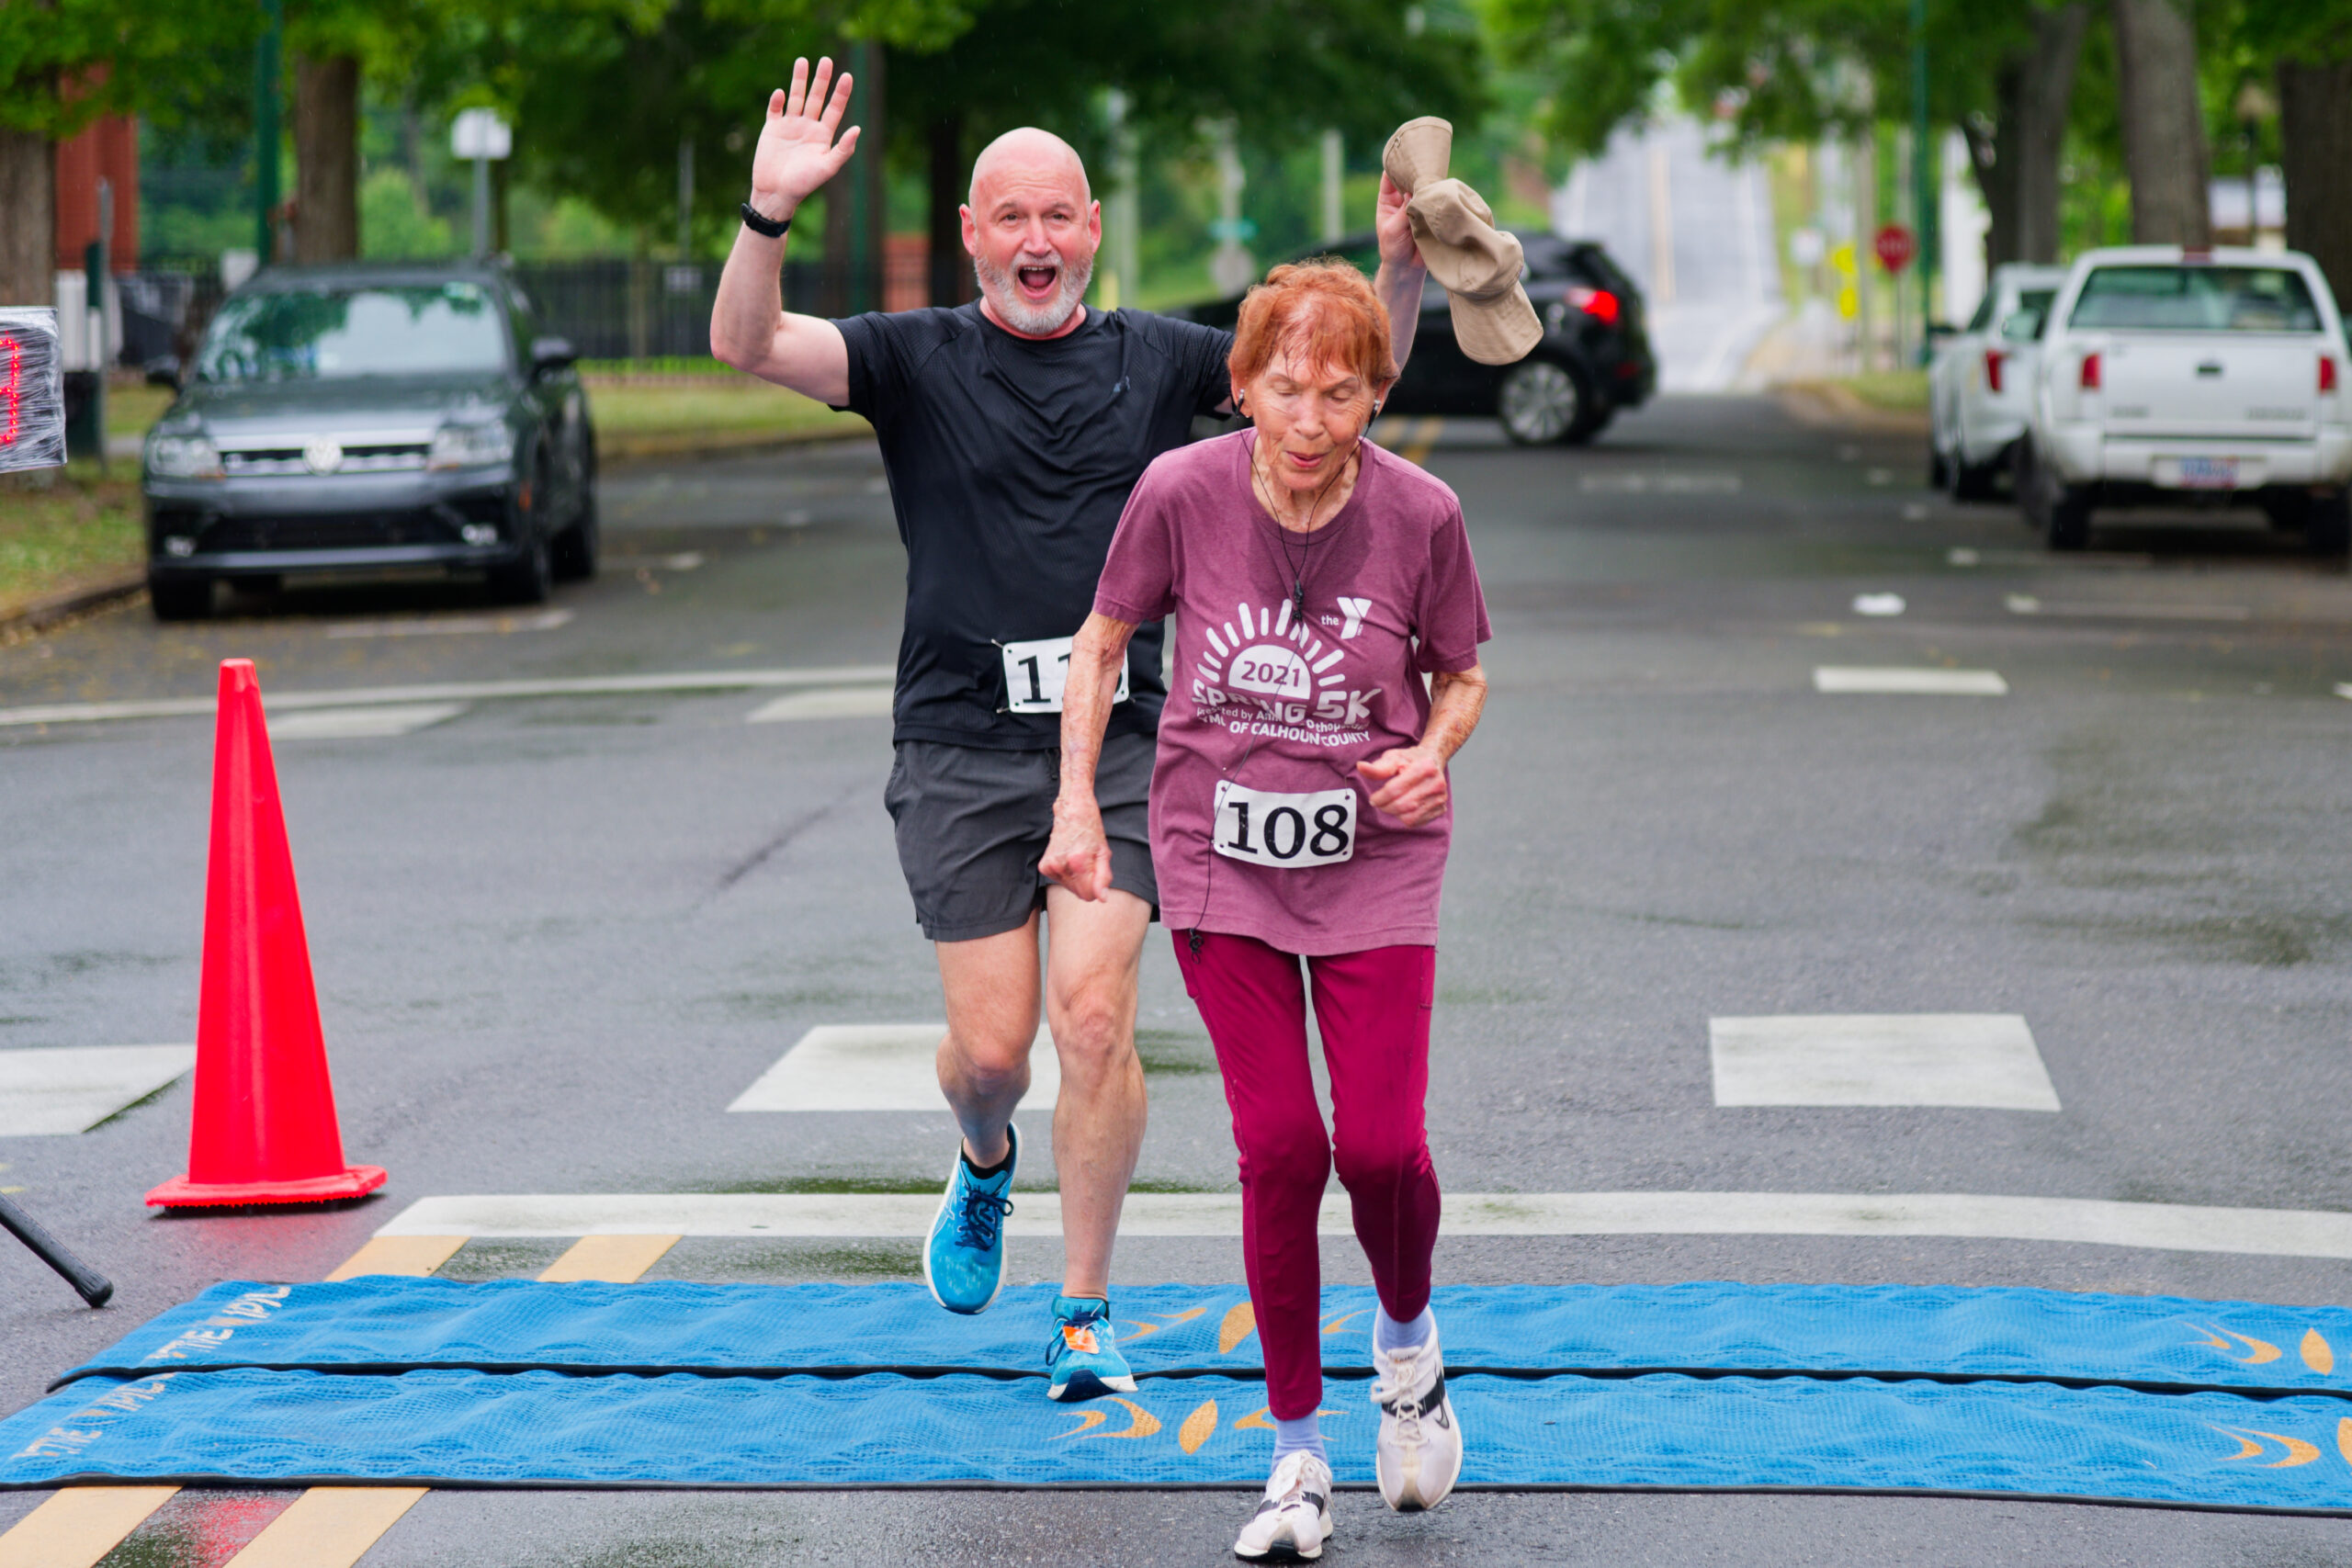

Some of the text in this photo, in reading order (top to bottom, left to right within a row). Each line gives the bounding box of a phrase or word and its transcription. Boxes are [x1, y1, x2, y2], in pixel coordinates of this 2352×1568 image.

[1321, 615, 1339, 626] the
[1241, 660, 1301, 687] 2021
[1241, 711, 1253, 720] by
[1312, 688, 1382, 726] 5K
[1229, 720, 1249, 734] OF
[1250, 722, 1320, 746] CALHOUN
[1320, 731, 1371, 747] COUNTY
[1227, 802, 1350, 860] 108
